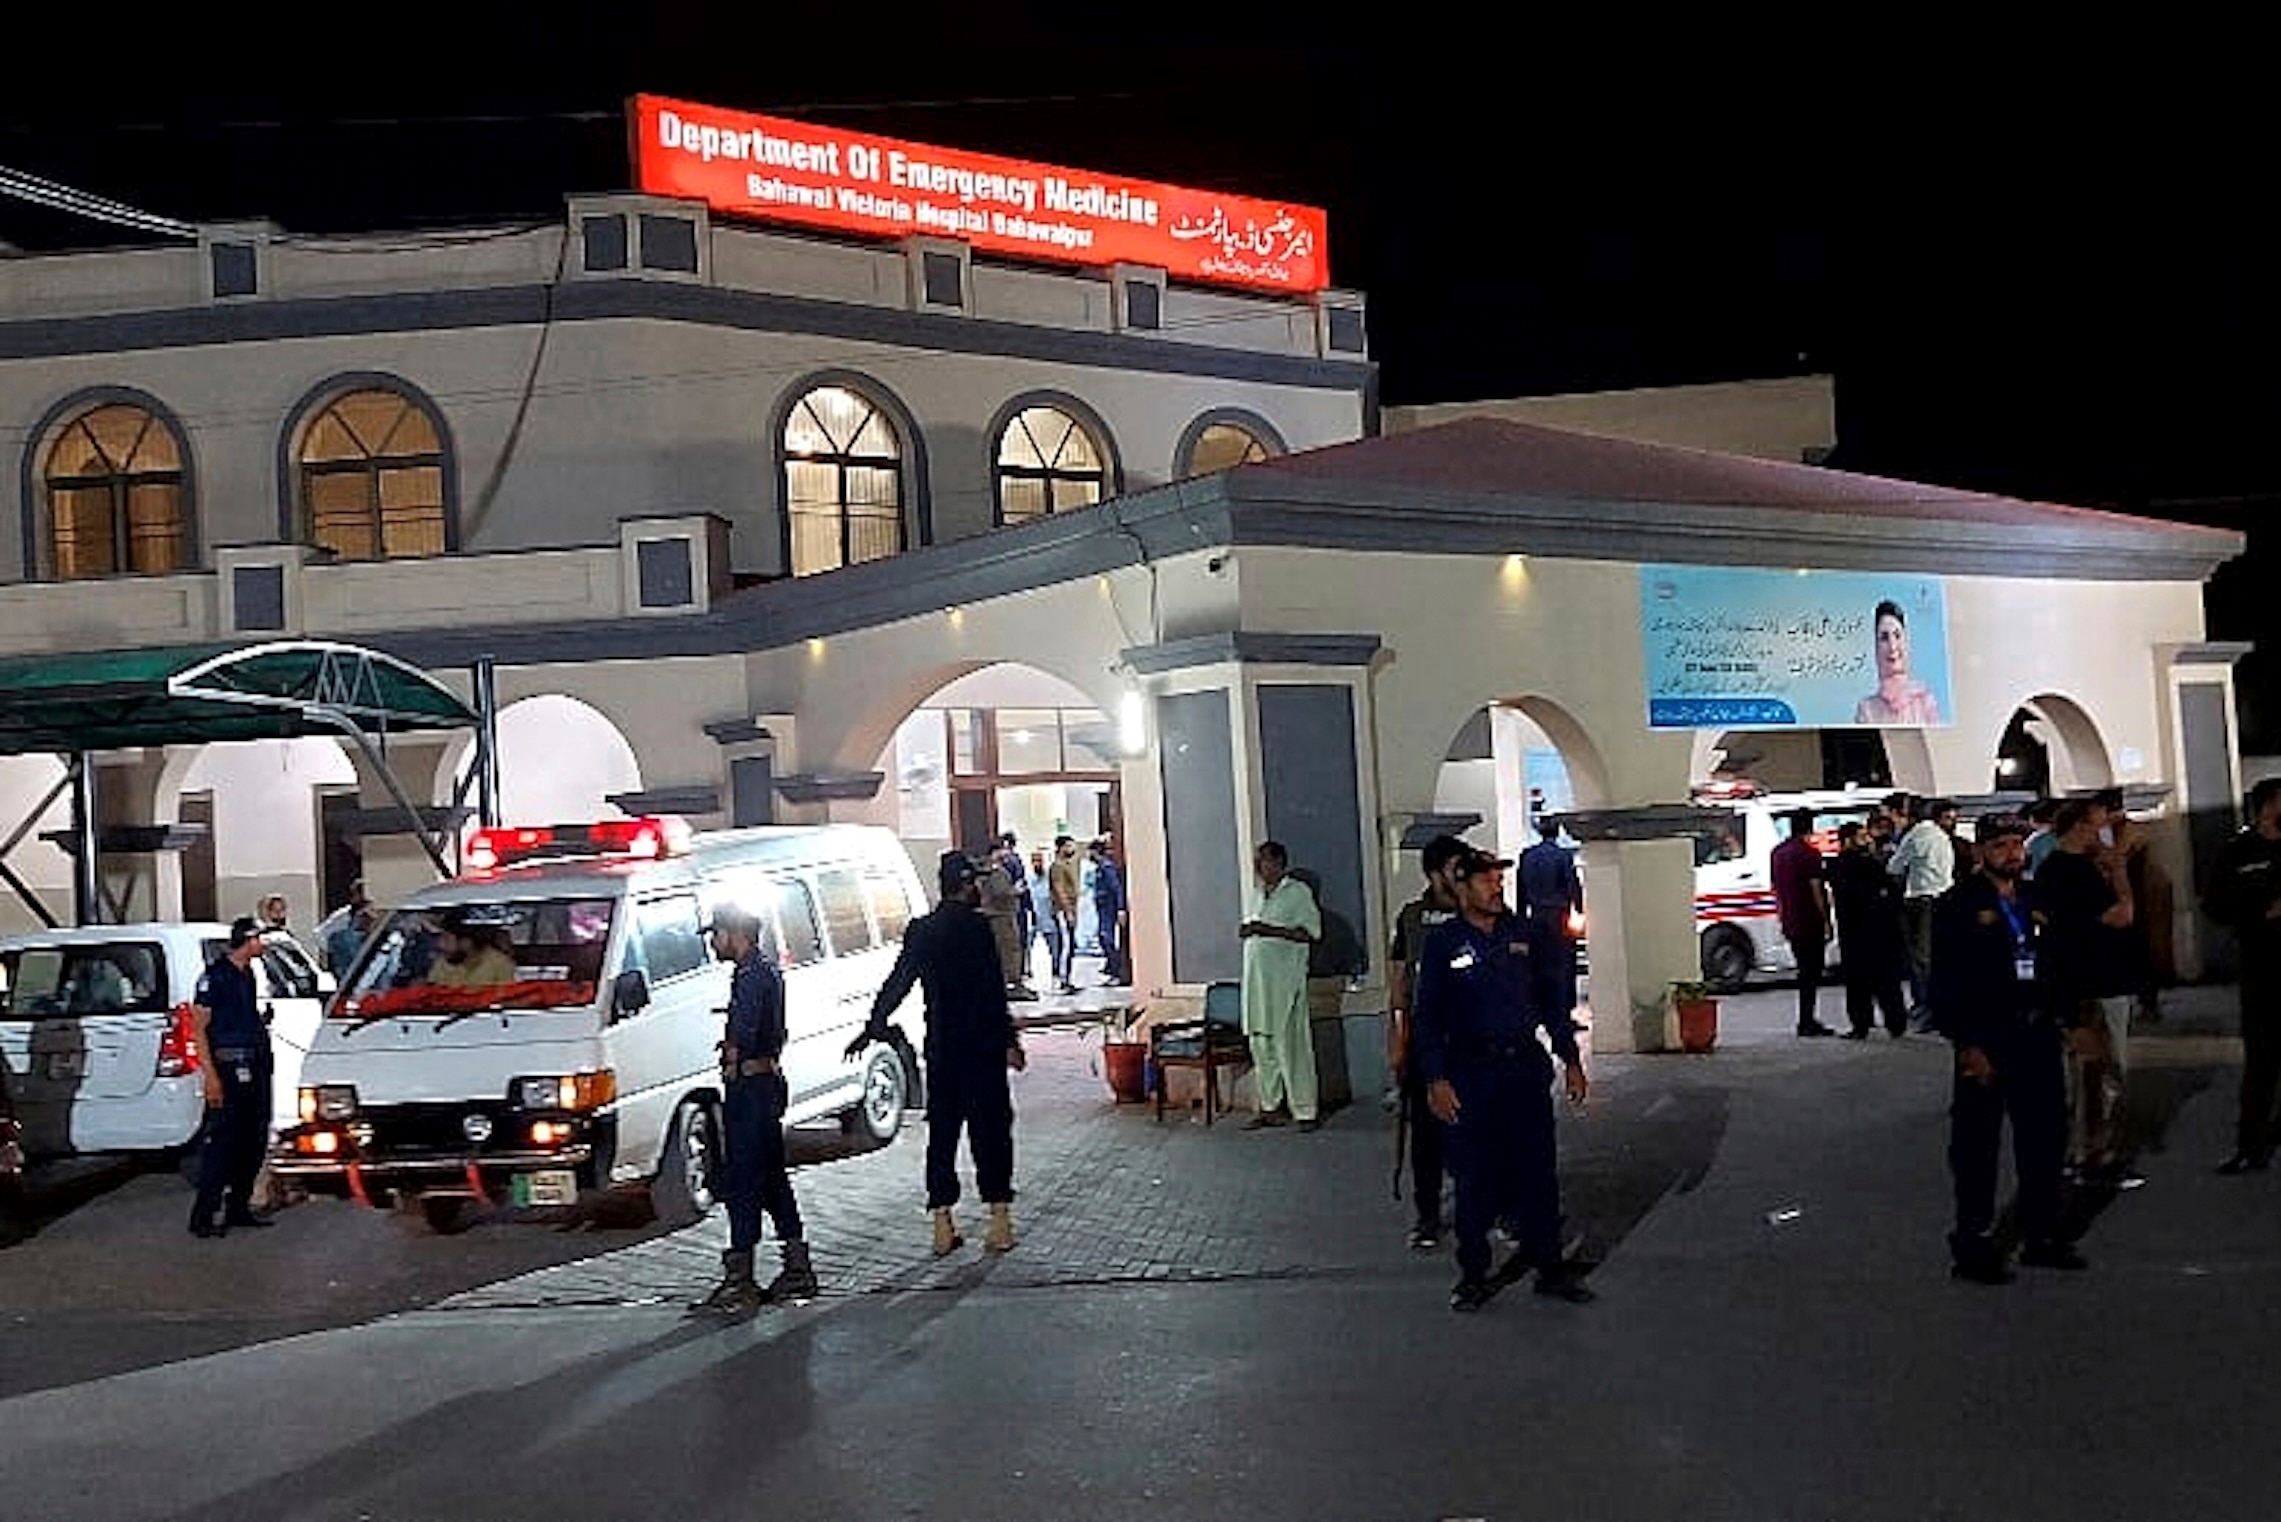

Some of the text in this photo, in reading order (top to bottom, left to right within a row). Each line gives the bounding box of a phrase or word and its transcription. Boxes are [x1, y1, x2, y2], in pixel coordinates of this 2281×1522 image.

[659, 110, 1158, 225] Department Of Emergency Medicine
[746, 173, 832, 209] Bahawal
[836, 187, 911, 221] Victoria
[916, 201, 988, 232] Hospital
